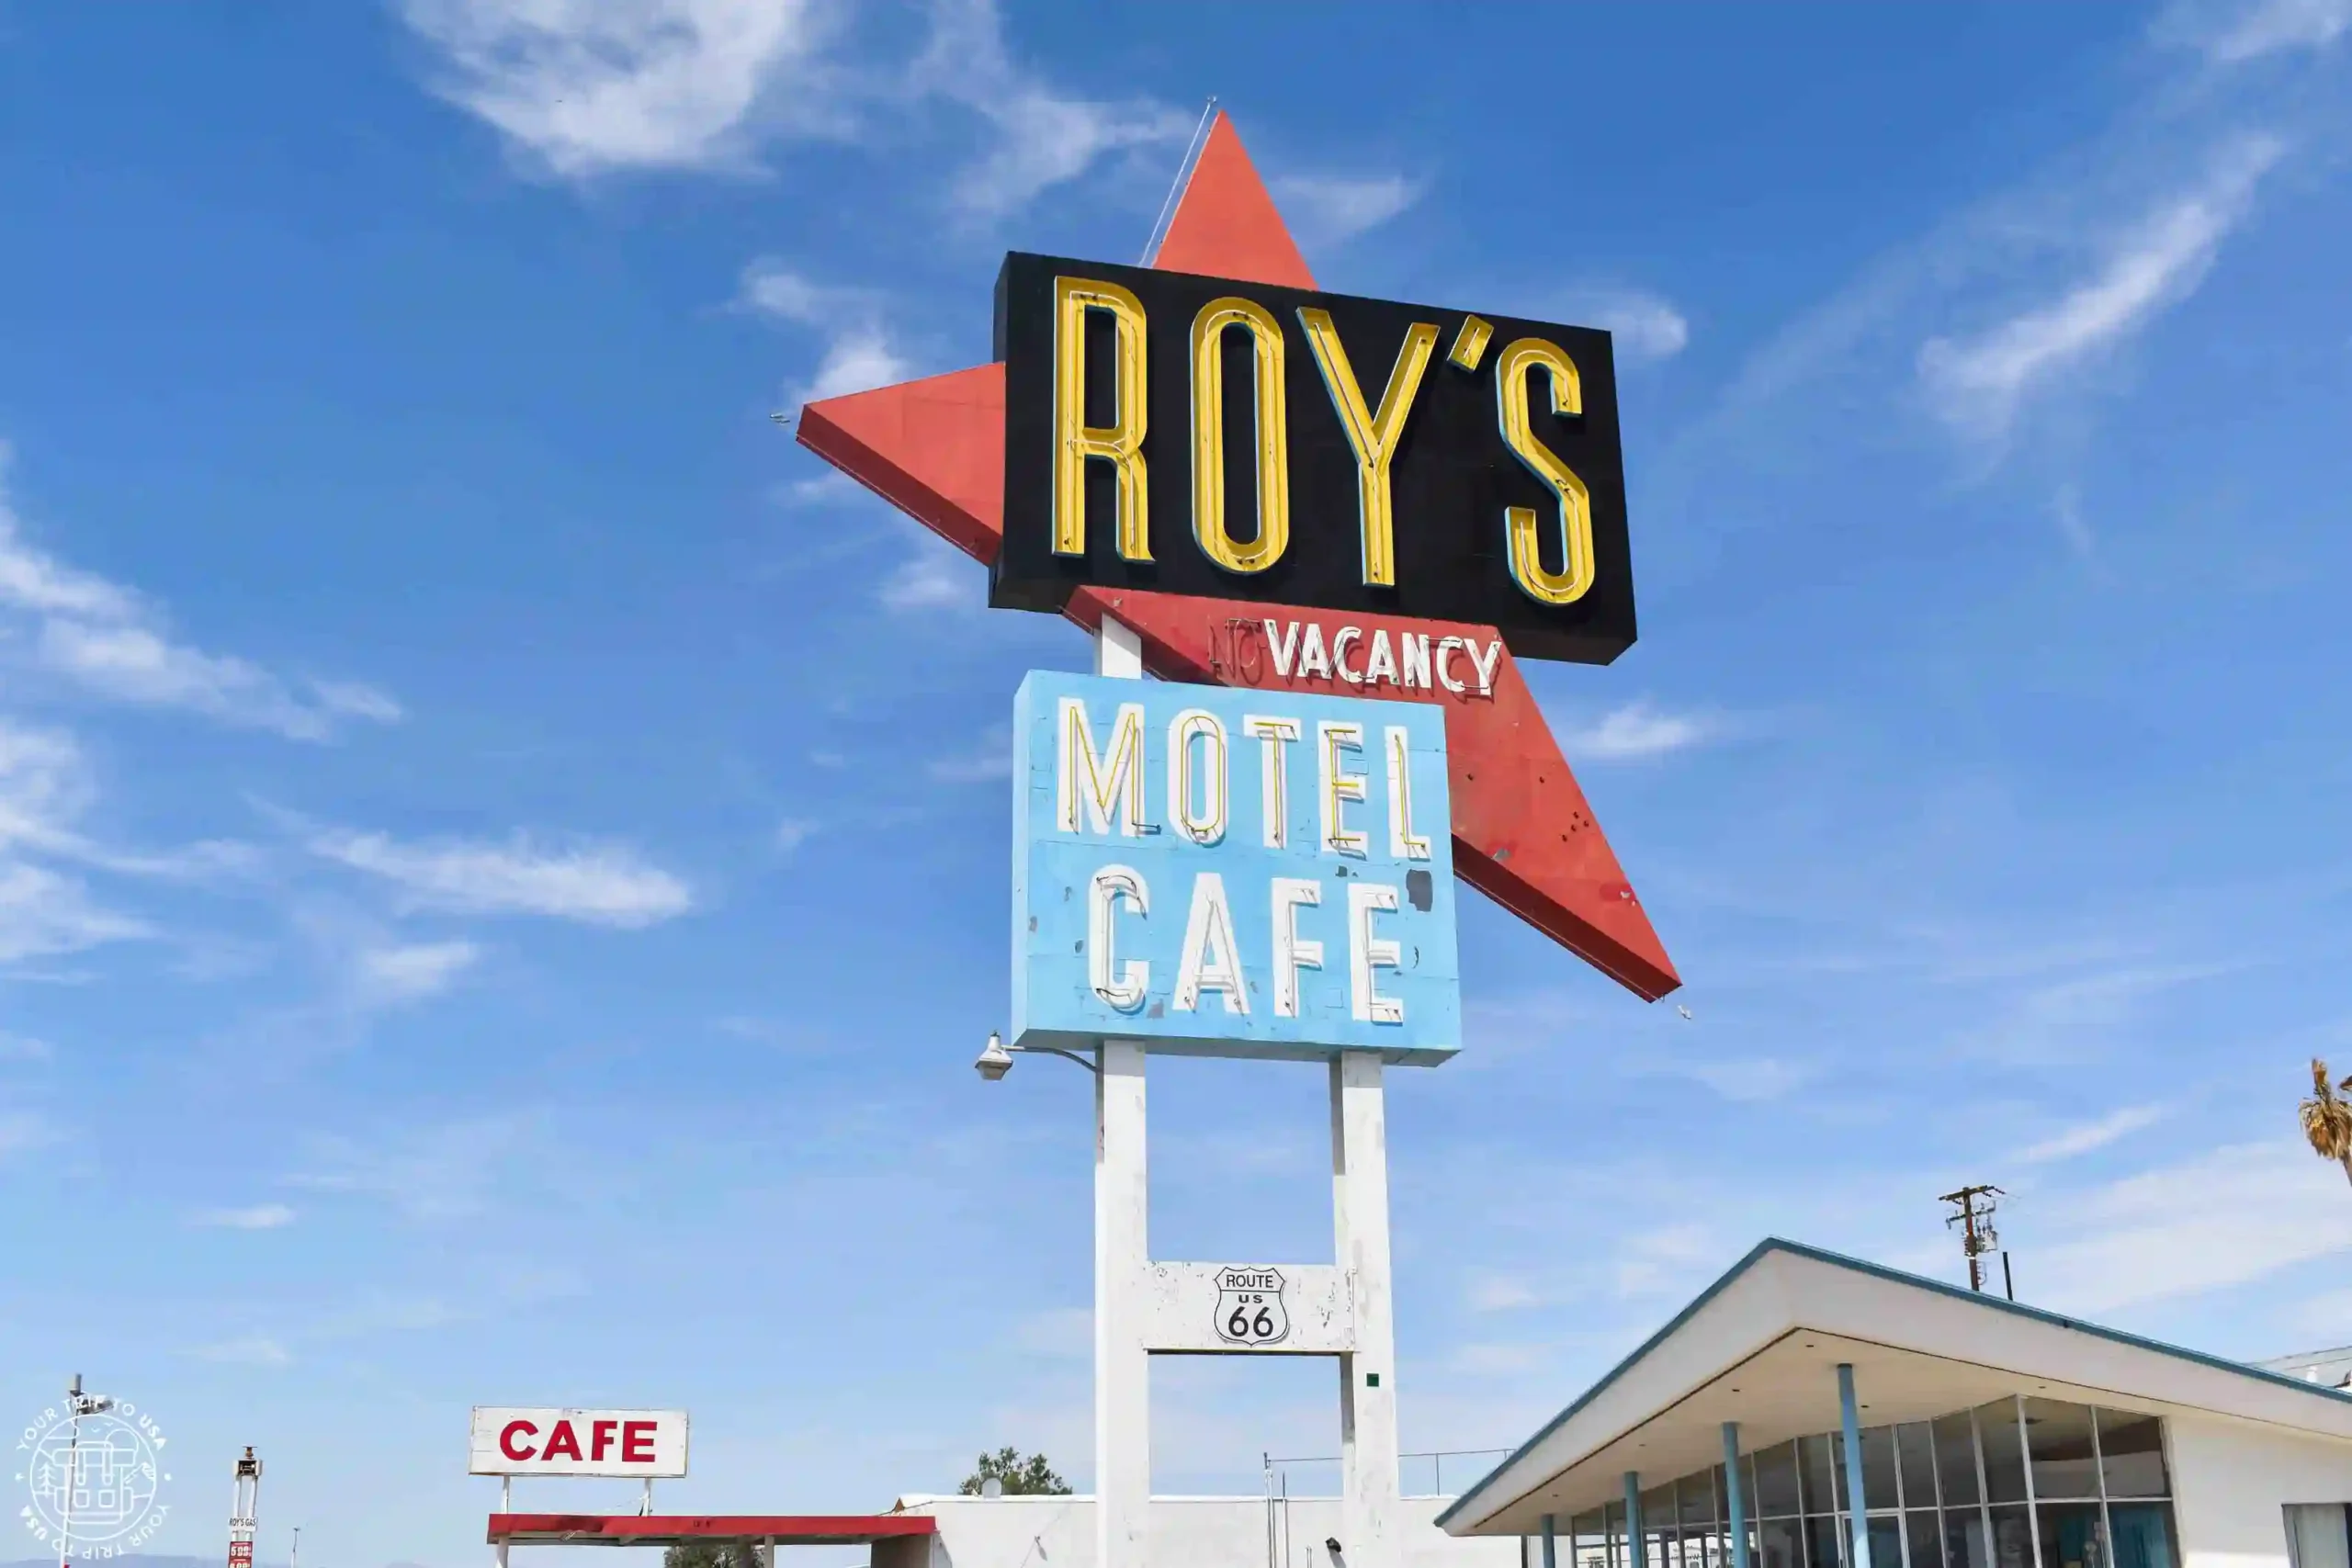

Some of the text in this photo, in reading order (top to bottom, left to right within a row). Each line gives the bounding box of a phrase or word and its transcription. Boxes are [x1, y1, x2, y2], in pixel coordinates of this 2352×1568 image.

[1052, 275, 1595, 606] ROY'S
[1262, 618, 1501, 696] VACANCY
[1057, 696, 1431, 859] MOTEL
[1088, 863, 1404, 1024] CAFE
[1227, 1274, 1273, 1288] ROUTE
[1228, 1306, 1273, 1337] 66
[499, 1419, 658, 1462] CAFE
